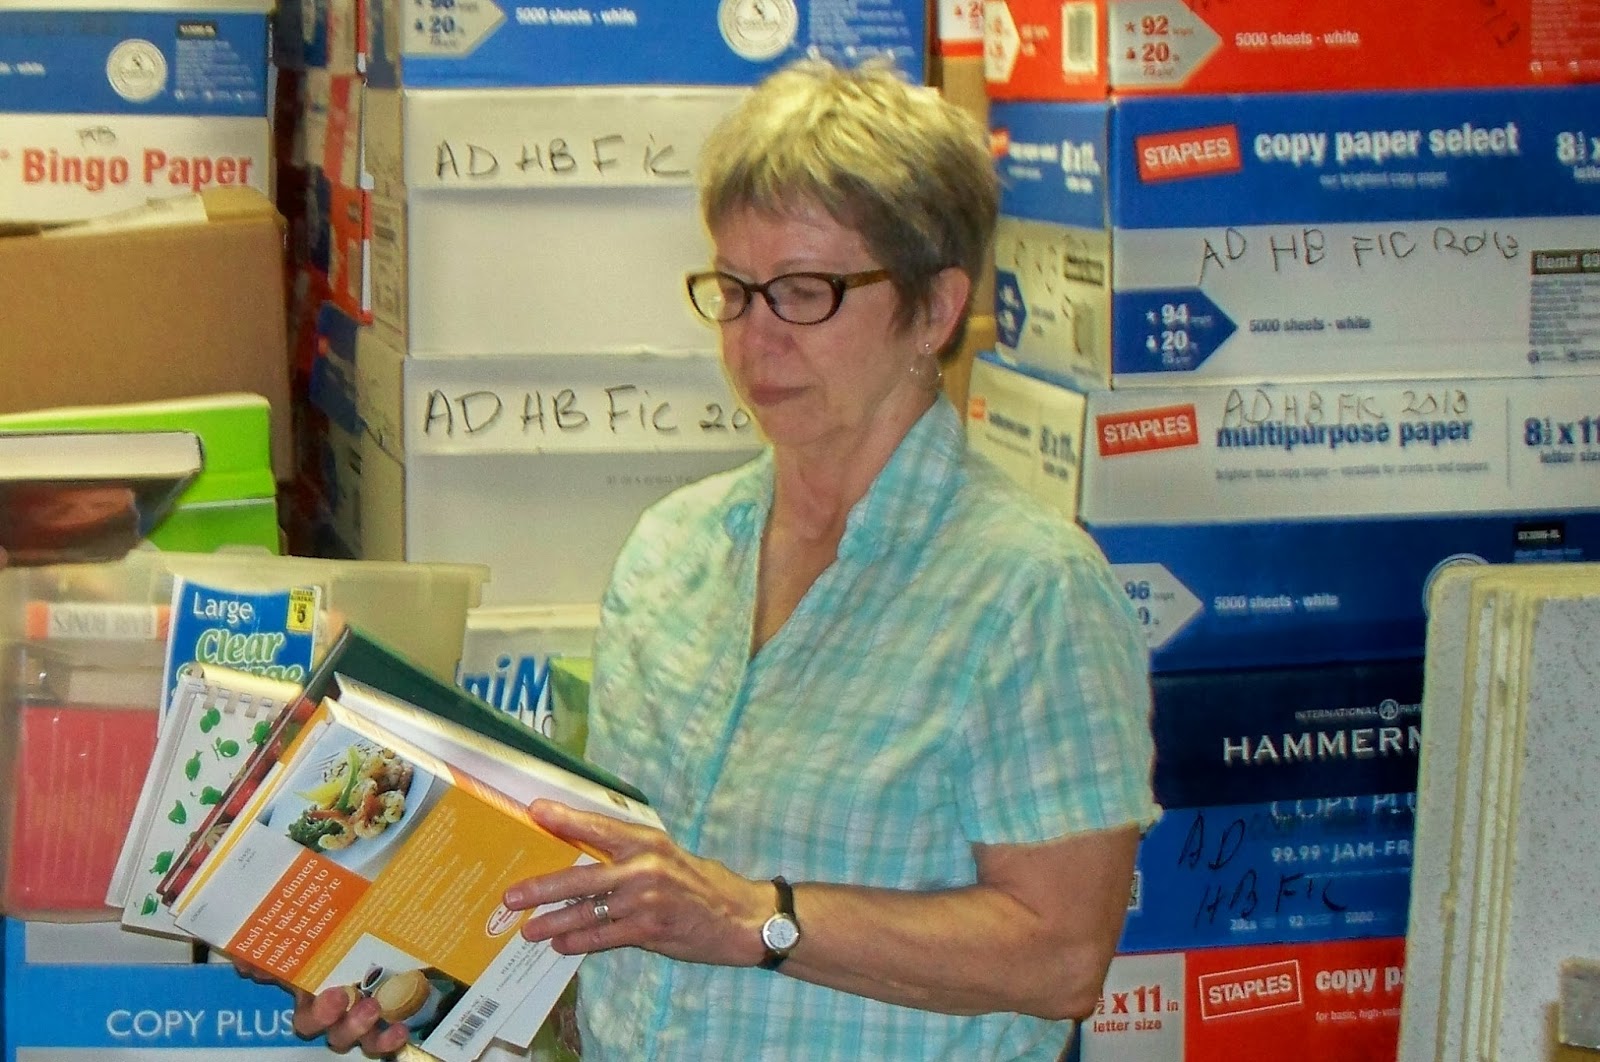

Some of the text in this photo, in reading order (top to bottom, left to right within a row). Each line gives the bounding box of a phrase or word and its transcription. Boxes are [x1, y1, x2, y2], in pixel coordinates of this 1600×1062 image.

[1142, 15, 1169, 35] 92
[1235, 30, 1359, 48] 5000 sheets white
[1142, 42, 1170, 62] 20
[436, 139, 499, 178] AD
[515, 138, 576, 172] HB
[1143, 136, 1232, 170] STAPLES
[1254, 131, 1326, 168] copy
[1335, 129, 1420, 164] paper
[1429, 122, 1519, 156] select
[23, 149, 252, 192] Bingo Paper
[1199, 227, 1247, 286] AD
[1270, 228, 1325, 272] HB
[1352, 231, 1416, 267] FIC
[1161, 304, 1190, 325] 94
[1250, 319, 1280, 332] 5000
[1284, 316, 1324, 331] sheets
[1161, 331, 1189, 351] 20
[424, 388, 502, 436] AD
[520, 388, 589, 434] HB
[1222, 389, 1272, 427] AD
[1284, 391, 1324, 426] HB
[1103, 414, 1192, 444] STAPLES
[1217, 421, 1391, 450] multipurpose
[1400, 420, 1473, 448] paper
[1125, 581, 1150, 599] 96
[193, 592, 253, 623] Large
[196, 628, 284, 665] Clear
[1295, 706, 1378, 719] INTERNATIONAL
[1178, 814, 1246, 869] AD
[236, 858, 318, 953] Rush hour dinners
[252, 868, 329, 960] don't take long to
[1194, 869, 1257, 928] HB
[265, 877, 342, 966] make, but they're
[277, 907, 338, 974] big on flavor.
[1133, 985, 1161, 1013] 11
[1167, 999, 1179, 1012] in
[1209, 974, 1292, 1005] STAPLES
[1315, 969, 1377, 994] copy
[106, 1009, 294, 1037] COPY PLUS
[1094, 1018, 1162, 1032] letter size
[1315, 1011, 1328, 1021] for
